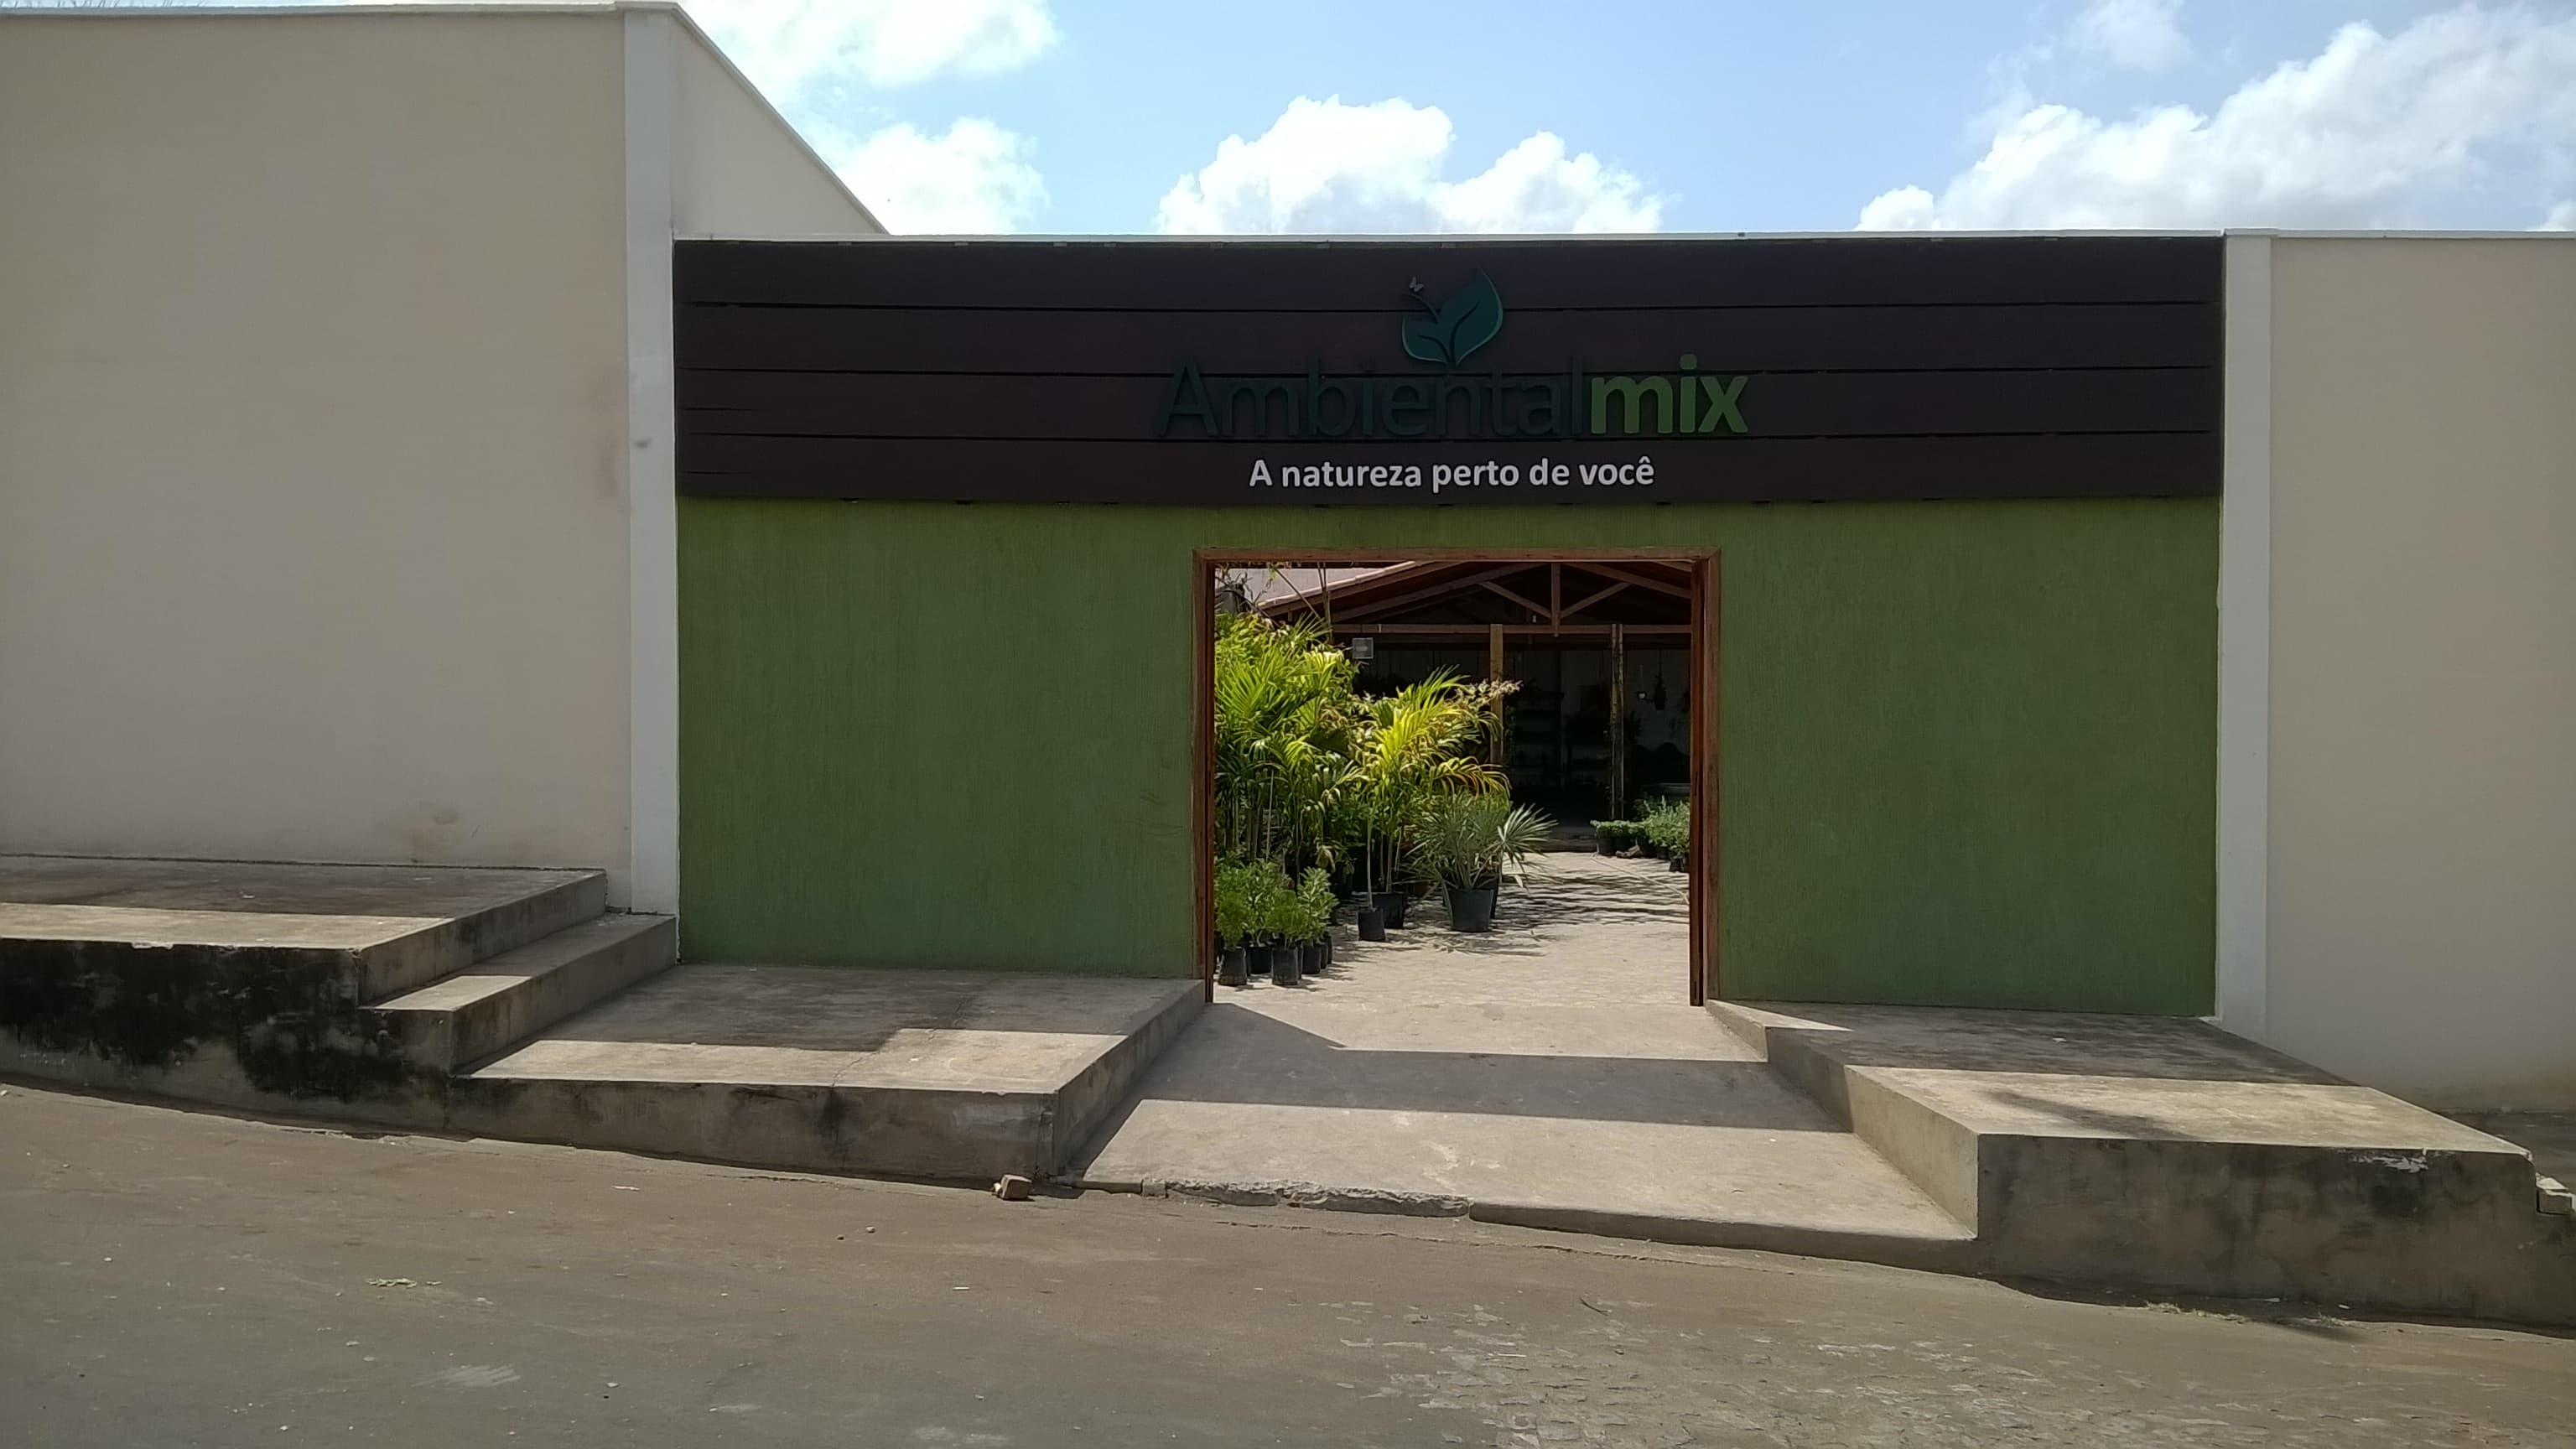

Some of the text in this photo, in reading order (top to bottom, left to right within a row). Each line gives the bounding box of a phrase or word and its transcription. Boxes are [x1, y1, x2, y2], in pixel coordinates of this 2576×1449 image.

[1249, 455, 1654, 493] A natureza perto de você
